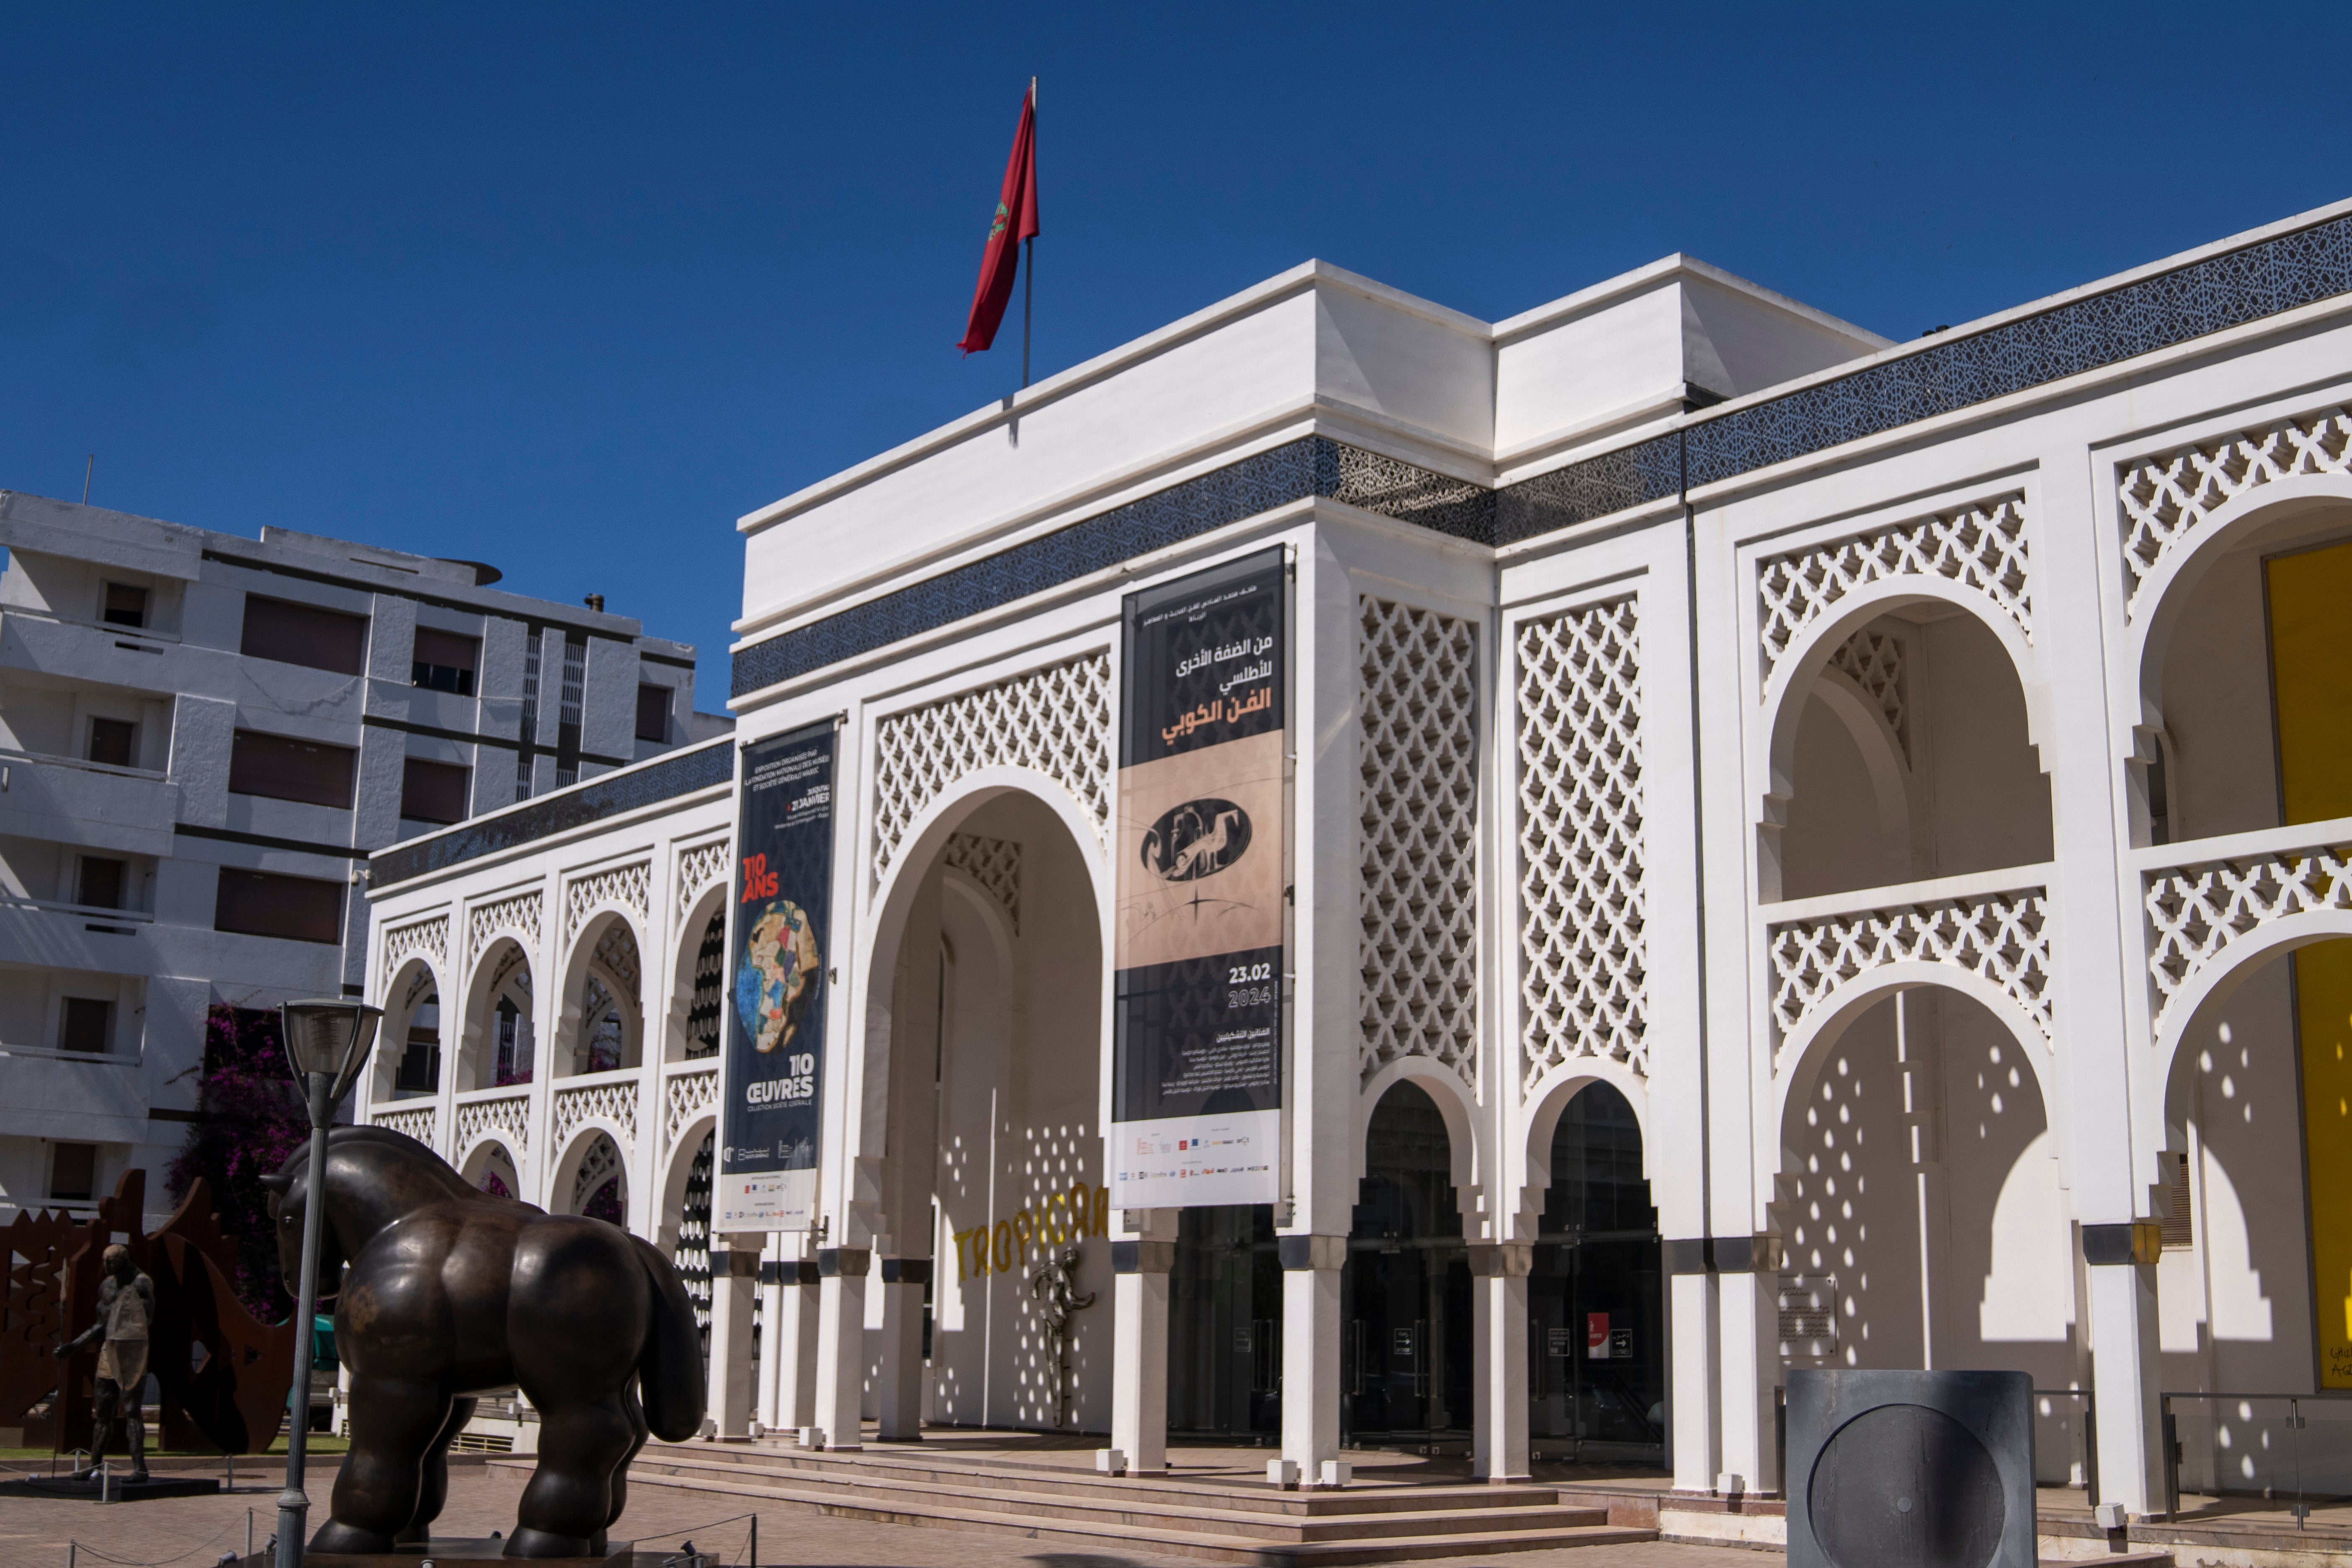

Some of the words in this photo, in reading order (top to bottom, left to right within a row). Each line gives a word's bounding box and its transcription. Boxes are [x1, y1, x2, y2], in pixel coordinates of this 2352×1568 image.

[1214, 638, 1251, 662] الضفة
[1253, 636, 1273, 655] من
[1176, 648, 1212, 678] الأخرى
[1219, 659, 1272, 696] للأطلسي
[1227, 687, 1271, 724] الفن
[1162, 699, 1222, 746] الكوبي
[751, 771, 776, 784] FONDATION
[776, 763, 802, 776] NATIONALE
[802, 759, 812, 769] DES
[755, 760, 781, 774] EXPOSITION
[807, 749, 818, 757] PAR
[799, 792, 830, 809] JANVIER
[743, 852, 766, 881] 110
[741, 872, 779, 903] ANS
[1229, 962, 1271, 984] 23.02
[1228, 986, 1271, 1008] 2024
[789, 1052, 815, 1076] 110
[746, 1075, 814, 1104] ŒUVRES
[747, 1104, 772, 1112] COLLECTION
